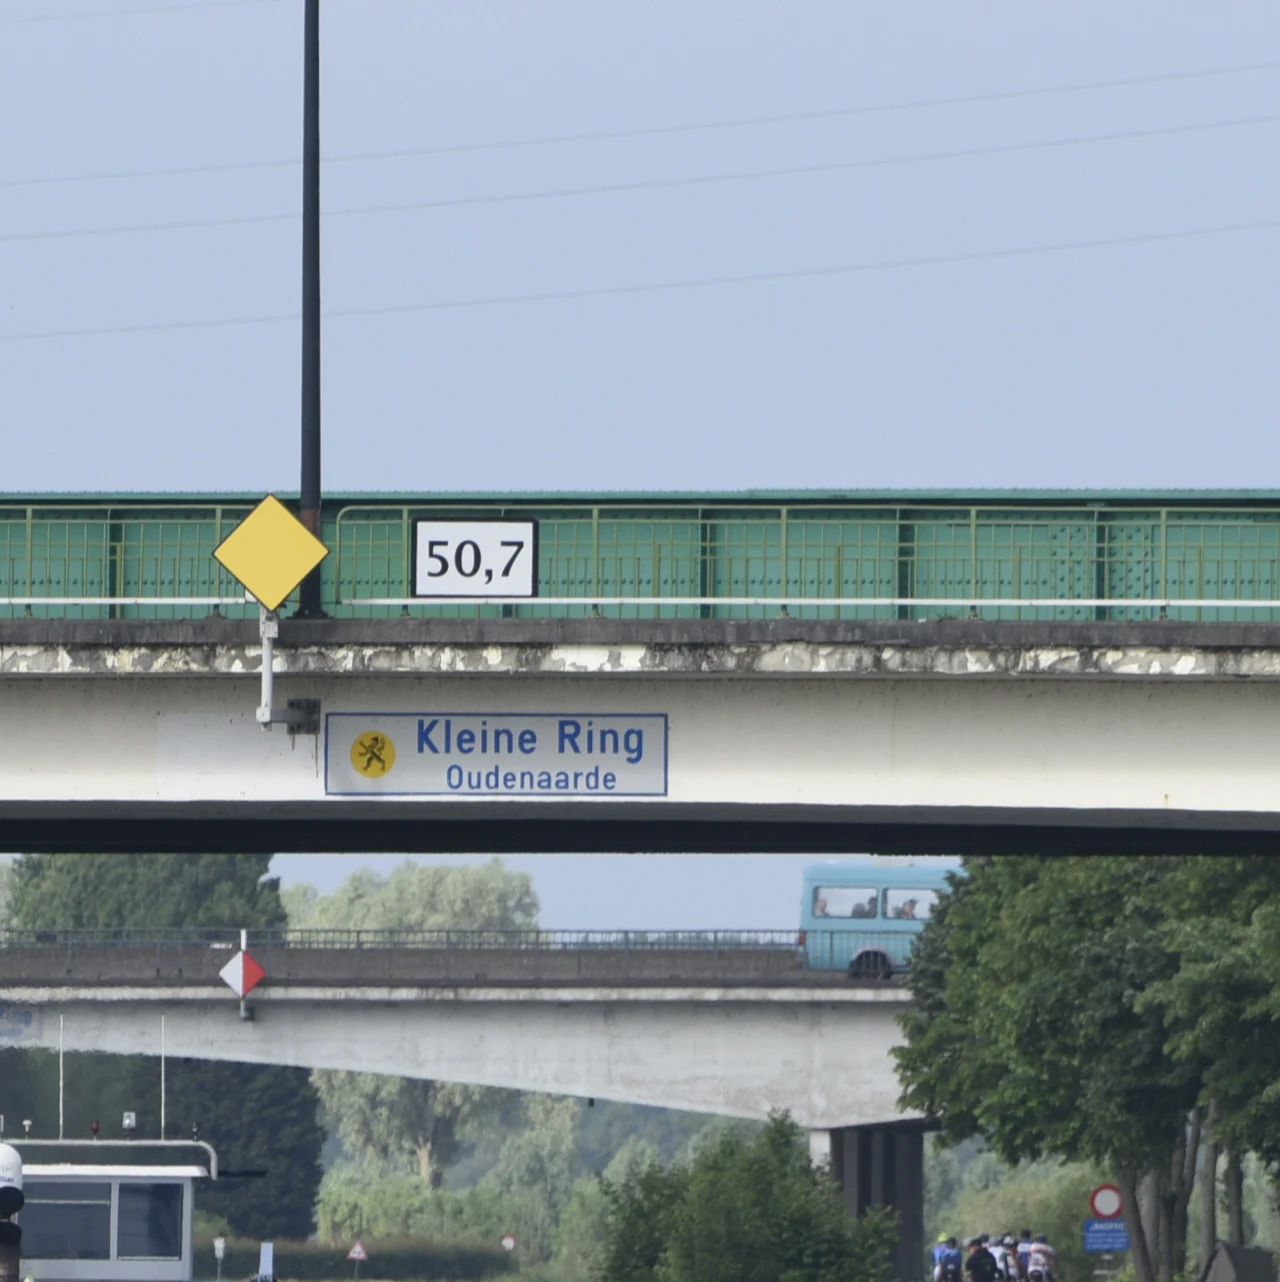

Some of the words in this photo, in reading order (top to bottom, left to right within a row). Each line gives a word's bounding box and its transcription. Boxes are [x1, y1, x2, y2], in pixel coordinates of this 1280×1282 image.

[426, 539, 525, 585] 50,7
[416, 718, 538, 755] Kleine
[558, 720, 645, 764] Ring
[445, 764, 618, 790] Oudenaarde
